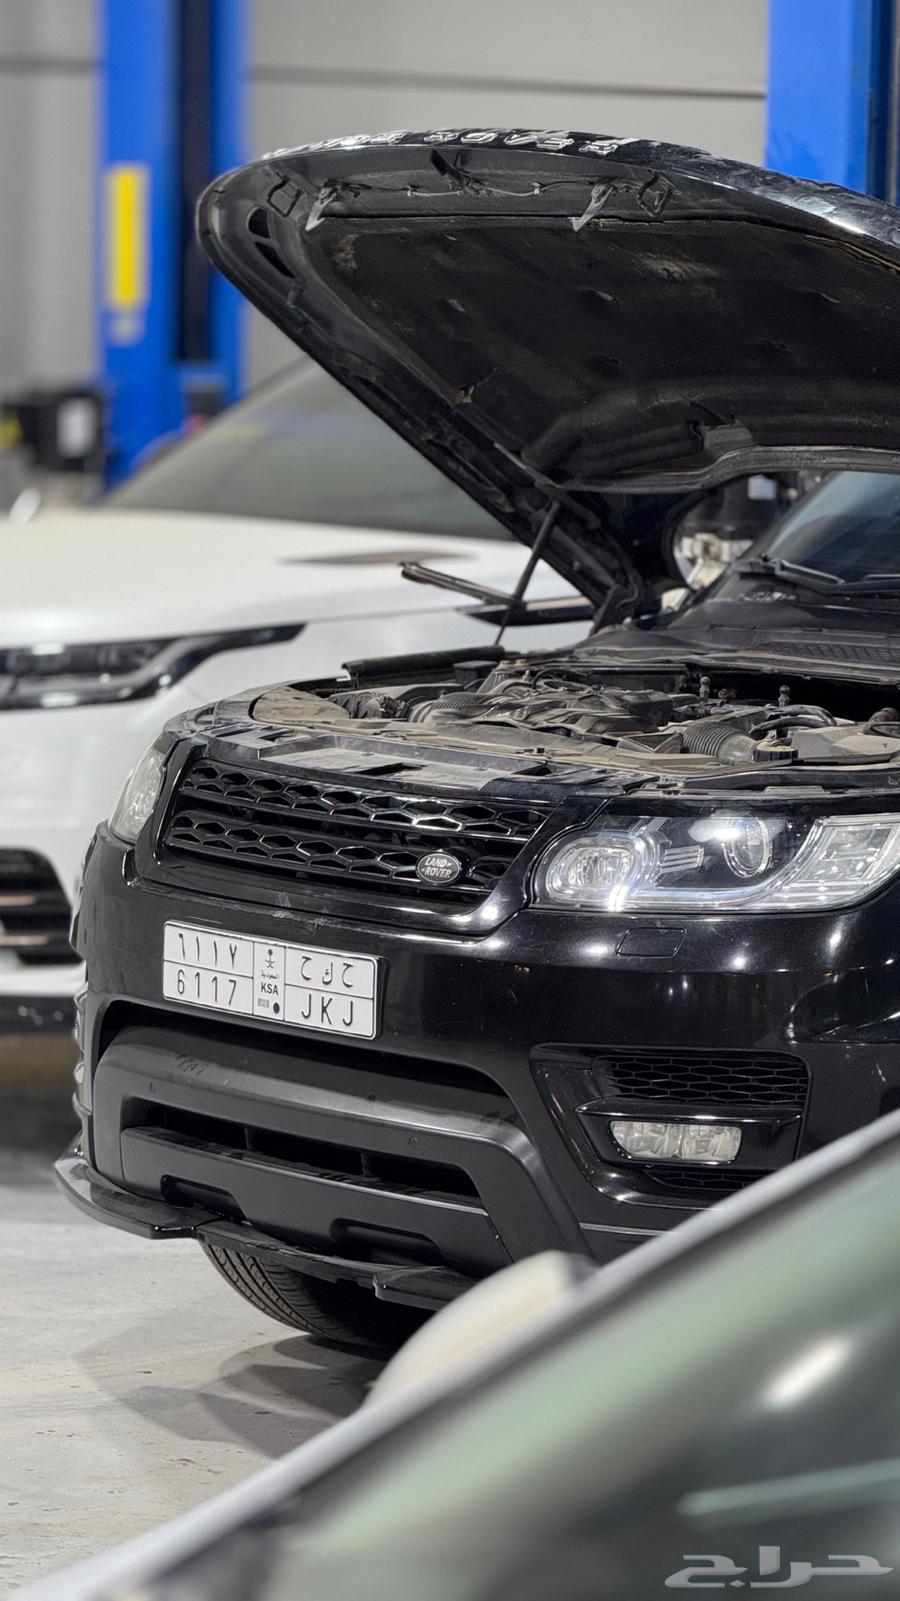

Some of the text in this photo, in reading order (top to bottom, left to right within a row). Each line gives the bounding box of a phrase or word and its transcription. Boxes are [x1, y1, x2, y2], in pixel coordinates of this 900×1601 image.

[424, 857, 448, 868] LAND
[424, 866, 452, 878] ROVER
[177, 969, 237, 1006] 6117
[260, 982, 279, 995] KSA
[301, 994, 354, 1026] JKJ
